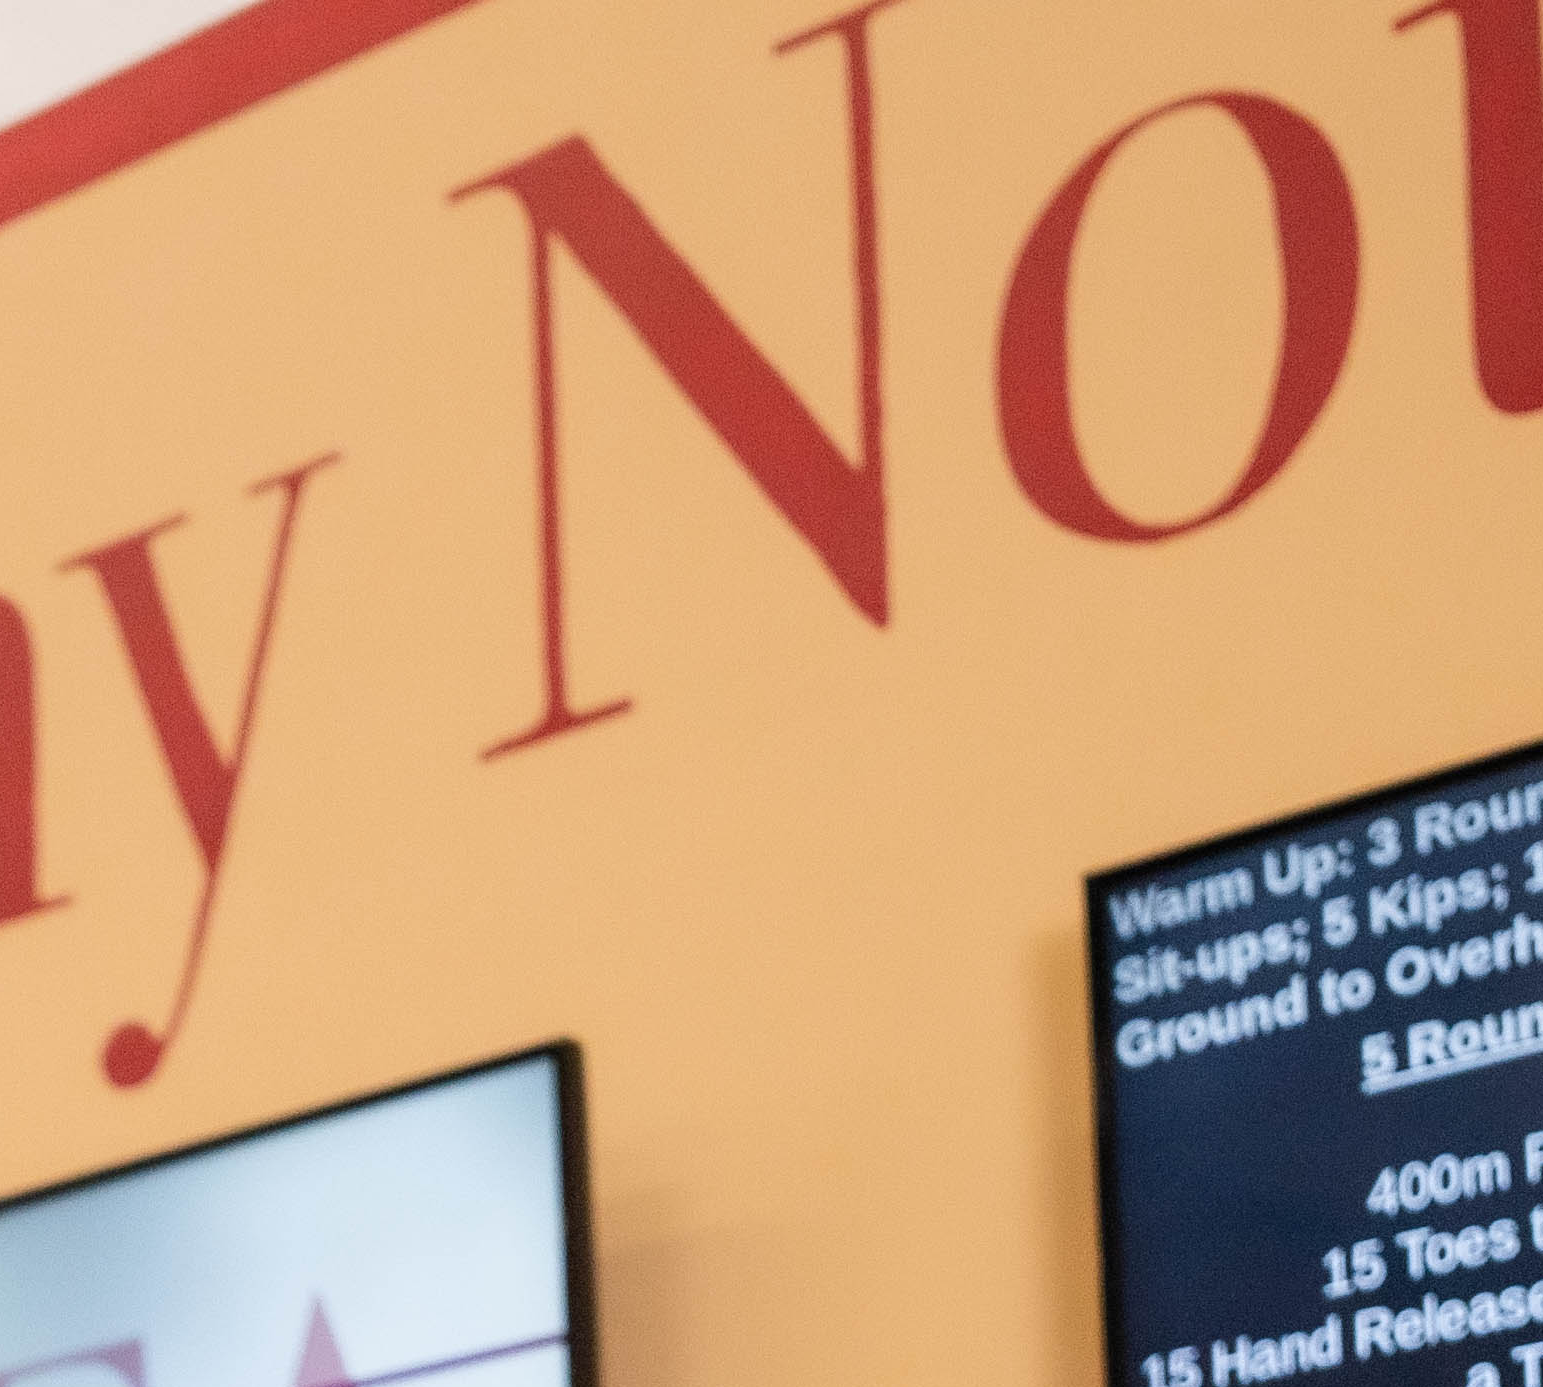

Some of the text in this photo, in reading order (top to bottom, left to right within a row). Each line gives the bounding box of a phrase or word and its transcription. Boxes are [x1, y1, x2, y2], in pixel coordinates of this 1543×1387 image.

[1109, 866, 1254, 940] Warm
[1262, 838, 1355, 899] Up:
[1367, 817, 1401, 868] 3
[1114, 917, 1312, 1003] Sit-ups;
[1321, 894, 1358, 948] 5
[1368, 862, 1510, 936] Kips;
[1116, 974, 1309, 1069] Ground
[1319, 967, 1375, 1016] to
[1360, 1030, 1398, 1087] 5
[1366, 1150, 1512, 1218] 400m
[1322, 1238, 1388, 1299] 15
[1394, 1217, 1520, 1282] Toes
